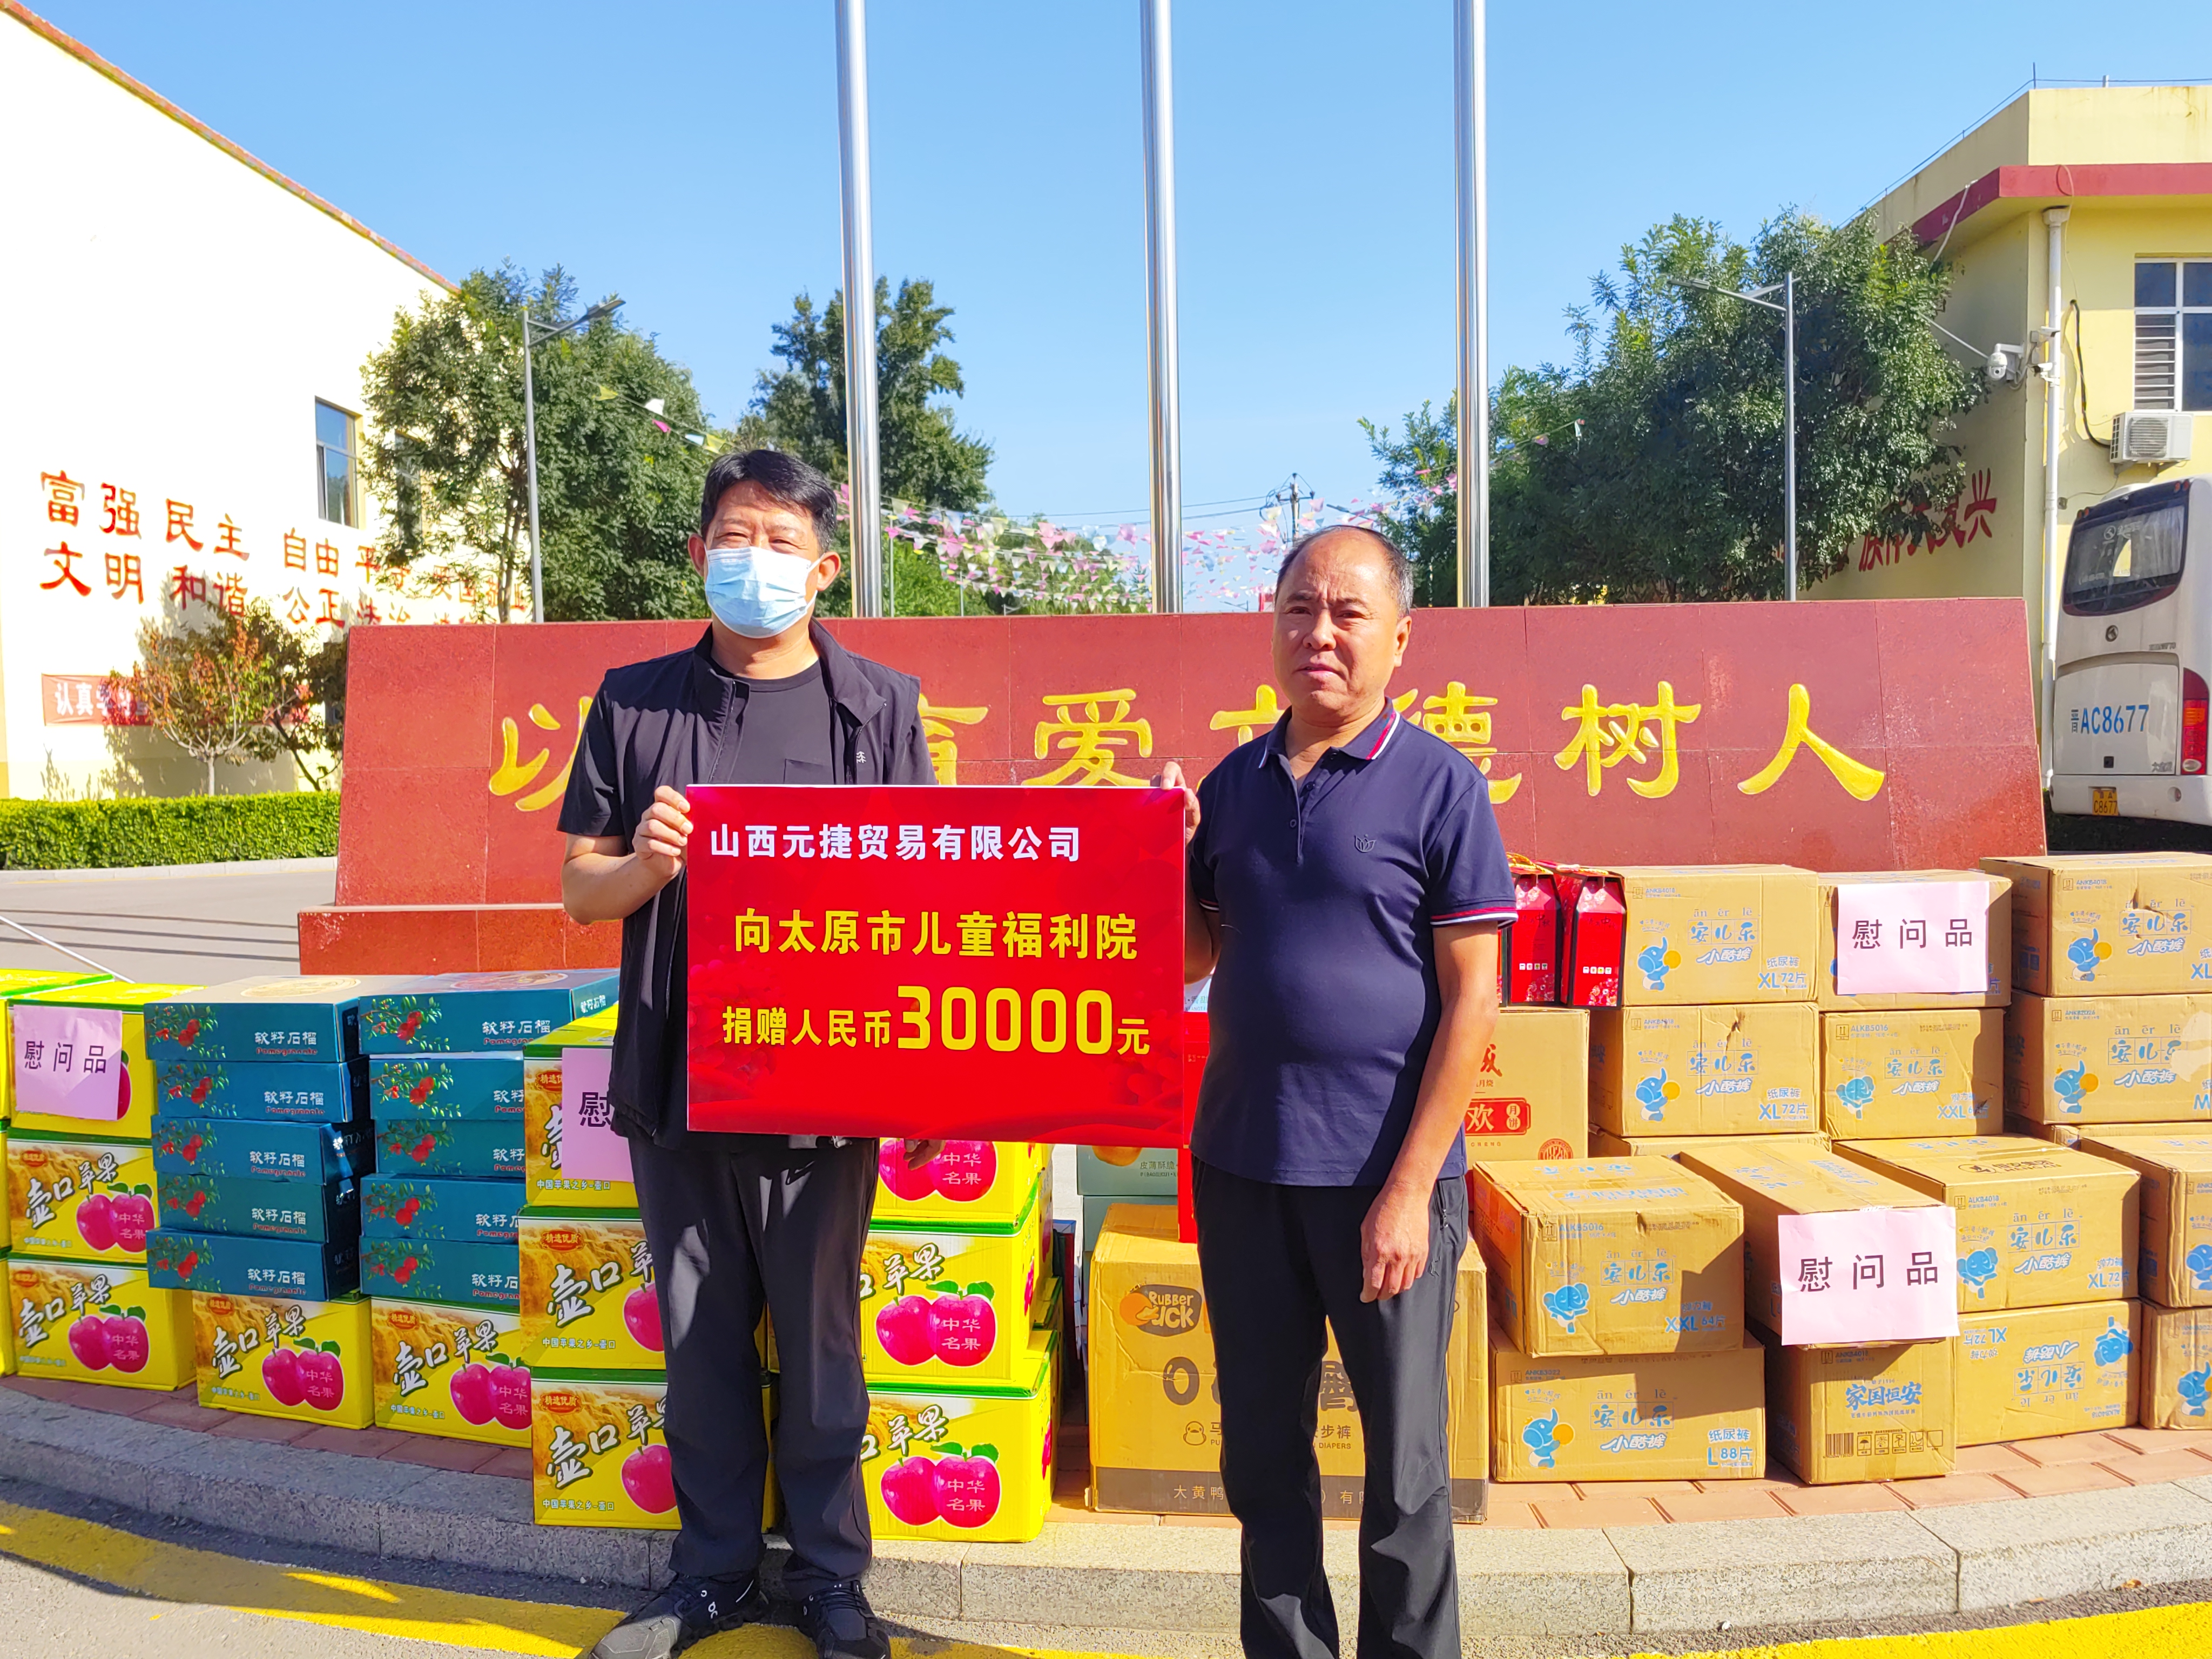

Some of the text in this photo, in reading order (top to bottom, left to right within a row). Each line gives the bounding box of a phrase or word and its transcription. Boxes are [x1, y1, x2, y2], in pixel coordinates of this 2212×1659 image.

[40, 470, 249, 561] 富强民主
[40, 542, 248, 619] 文明和谐
[710, 824, 1080, 862] 山西元捷贸易有限公司
[2122, 913, 2188, 934] 安儿乐
[734, 908, 1138, 960] 向太原市儿童福利院
[1690, 921, 1756, 943] 安儿乐
[1851, 919, 1973, 949] 慰问品
[2127, 937, 2186, 956] 小酷裤
[1696, 947, 1754, 966] 小酷裤
[1766, 956, 1800, 968] 纸尿裤
[2190, 963, 2212, 979] XL
[1758, 972, 1806, 988] XL 72片
[482, 1019, 551, 1035] 软籽石榴
[722, 985, 1151, 1056] 捐赠人民币30000元
[255, 1031, 317, 1046] 软籽石榴
[2114, 1026, 2130, 1035] ān
[24, 1040, 107, 1074] 慰问品
[1690, 1053, 1755, 1074] 安儿乐
[1887, 1058, 1943, 1077] 安儿乐
[1695, 1078, 1753, 1097] 小酷裤
[1767, 1088, 1801, 1100] 纸尿裤
[1892, 1080, 1940, 1095] 小酷裤
[264, 1091, 324, 1106] 软籽石榴
[2194, 1094, 2211, 1110] M
[1758, 1103, 1808, 1121] XL 72片
[1937, 1105, 1966, 1119] XXL
[249, 1151, 305, 1168] 软籽石榴
[943, 1152, 982, 1166] 中华
[536, 1179, 611, 1190] 中国苹果之乡-壶口
[942, 1171, 982, 1186] 名果
[26, 1152, 119, 1230] 壶口苹果
[119, 1213, 145, 1225] 中华
[251, 1208, 307, 1225] 软籽石榴
[2013, 1213, 2027, 1222] ān
[2062, 1208, 2073, 1219] lè
[119, 1228, 146, 1240] 名果
[2010, 1224, 2077, 1250] 安儿乐
[2014, 1252, 2072, 1275] 小酷裤
[247, 1267, 306, 1285] 软籽石榴
[1604, 1262, 1670, 1284] 安儿乐
[1798, 1251, 1939, 1293] 慰问品
[2088, 1273, 2107, 1289] XL
[1610, 1287, 1668, 1306] 小酷裤
[19, 1273, 112, 1348] 壶口苹果
[942, 1317, 981, 1333] 中华
[1664, 1315, 1726, 1332] XXL 64片
[112, 1334, 139, 1346] 中华
[212, 1304, 307, 1380] 壶口苹果
[1988, 1327, 2007, 1343] XL
[542, 1337, 616, 1350] 中国苹果之乡-壶口
[941, 1337, 982, 1351] 名果
[113, 1349, 140, 1361] 名果
[393, 1319, 499, 1397] 壶口苹果
[306, 1370, 333, 1383] 中华
[307, 1385, 335, 1398] 名果
[498, 1385, 528, 1400] 中华
[1596, 1390, 1613, 1400] ān
[1845, 1381, 1923, 1411] 家国恒安
[498, 1402, 529, 1416] 名果
[1594, 1404, 1671, 1428] 安儿乐
[1600, 1432, 1668, 1453] 小酷裤
[1708, 1428, 1751, 1442] 纸尿裤
[1707, 1446, 1754, 1466] L 88片
[947, 1479, 986, 1495] 中华
[542, 1499, 615, 1511] 中国苹果之乡-壶口
[946, 1497, 986, 1512] 名果
